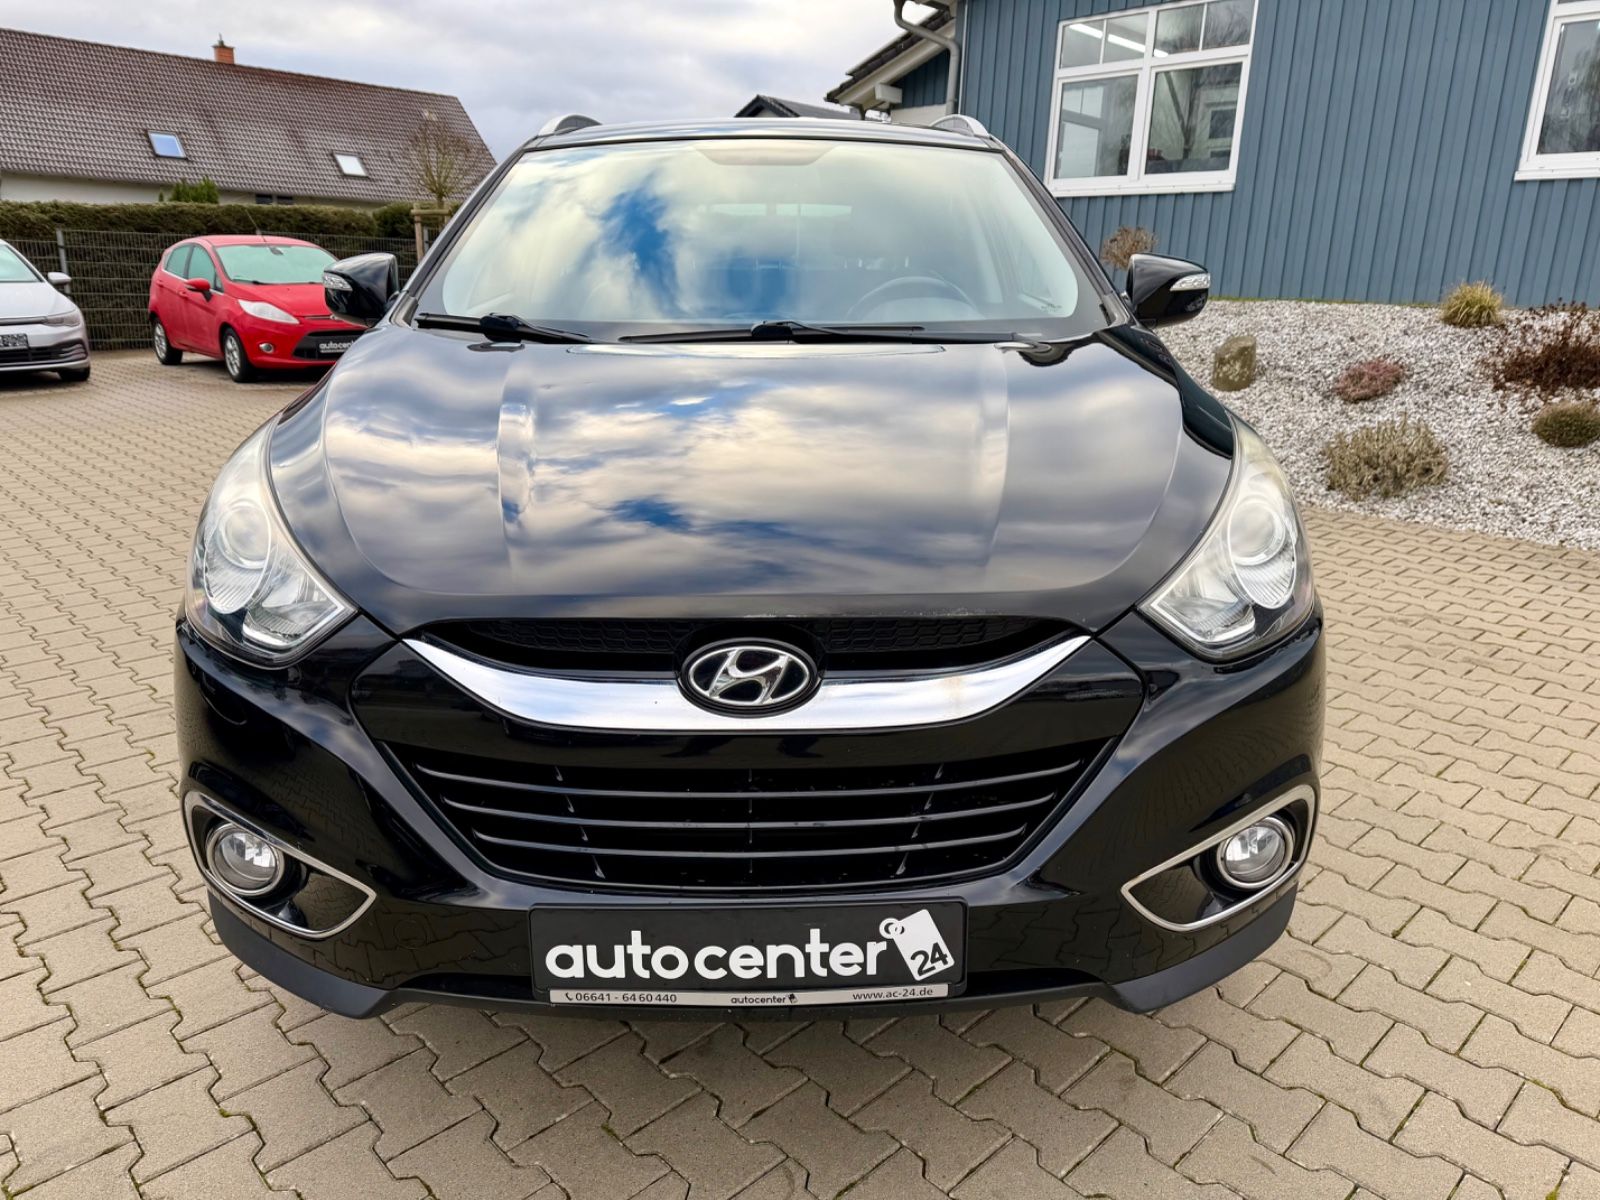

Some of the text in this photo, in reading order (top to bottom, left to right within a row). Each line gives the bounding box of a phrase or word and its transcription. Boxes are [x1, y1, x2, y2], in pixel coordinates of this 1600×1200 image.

[910, 942, 949, 977] 24
[575, 992, 611, 1002] 06641
[730, 994, 786, 1005] autocenter
[852, 987, 934, 1000] www.ac-24.de
